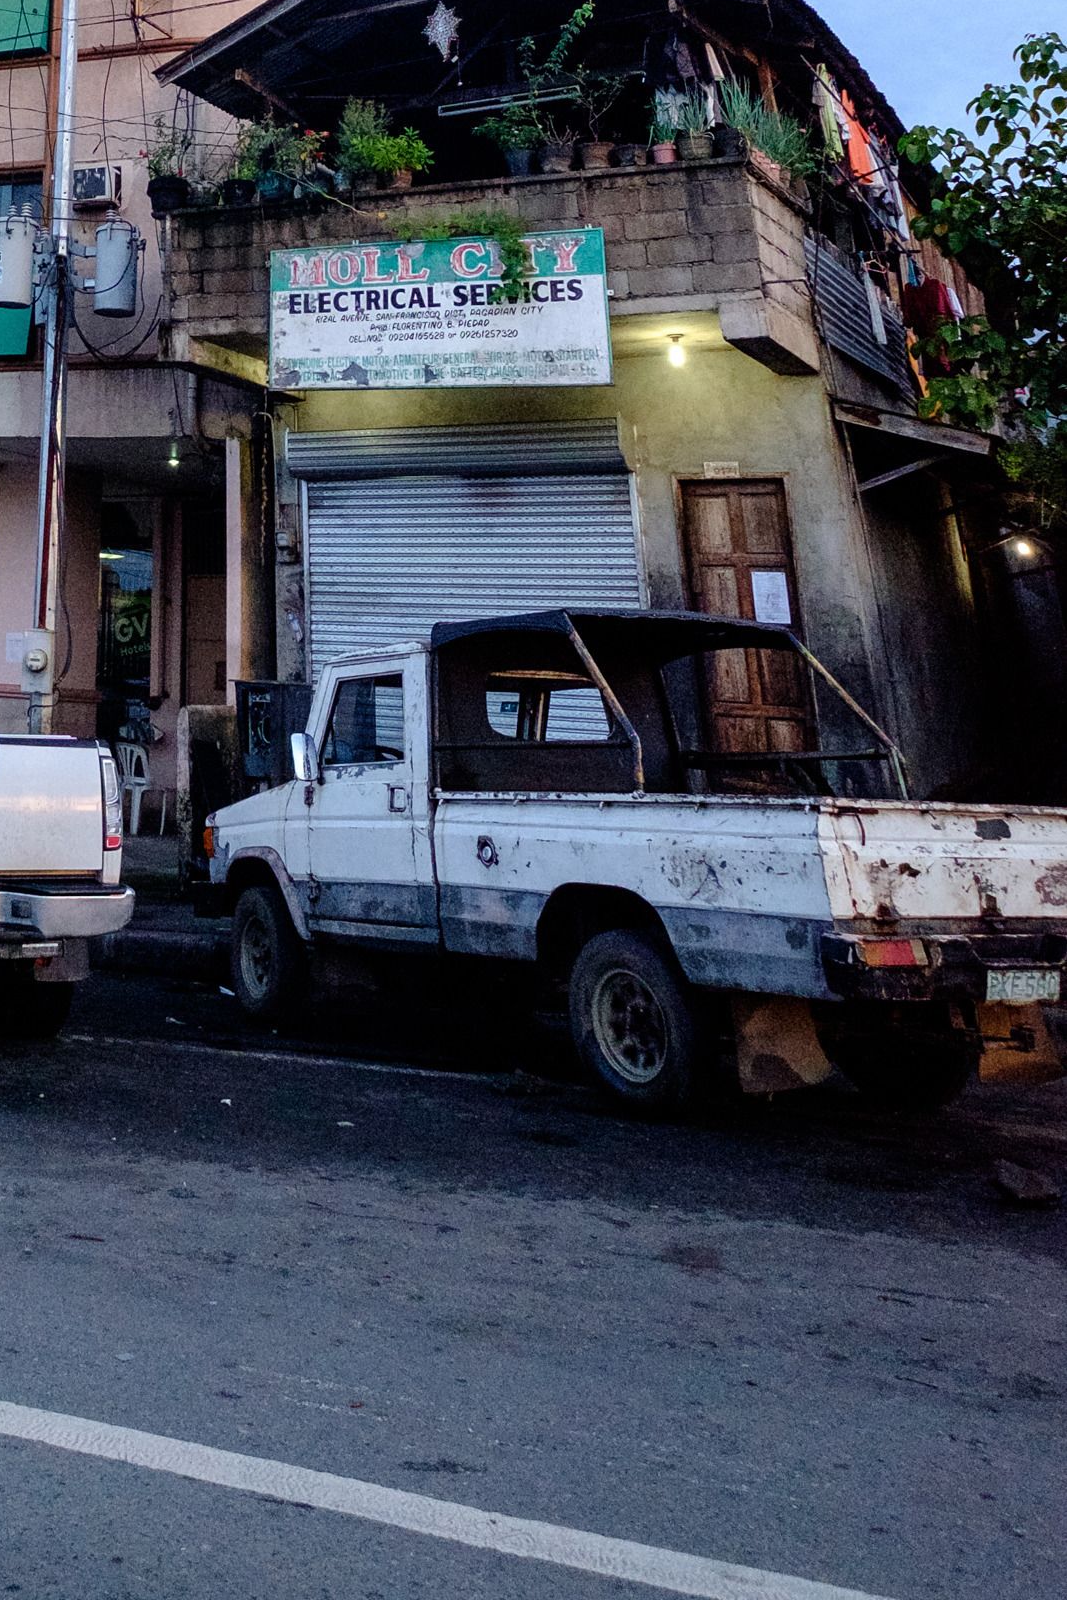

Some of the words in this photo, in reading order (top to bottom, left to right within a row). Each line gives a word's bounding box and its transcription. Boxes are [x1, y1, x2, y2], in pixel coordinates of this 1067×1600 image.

[289, 242, 431, 288] MOLL
[288, 286, 442, 314] ELECTRICAL
[315, 314, 337, 324] RIZAL
[520, 305, 544, 315] CITY
[392, 321, 442, 331] FLORENTINO
[458, 318, 490, 328] PIEDAD
[448, 331, 457, 339] or
[459, 330, 519, 340] 09261257320
[115, 613, 149, 642] GV
